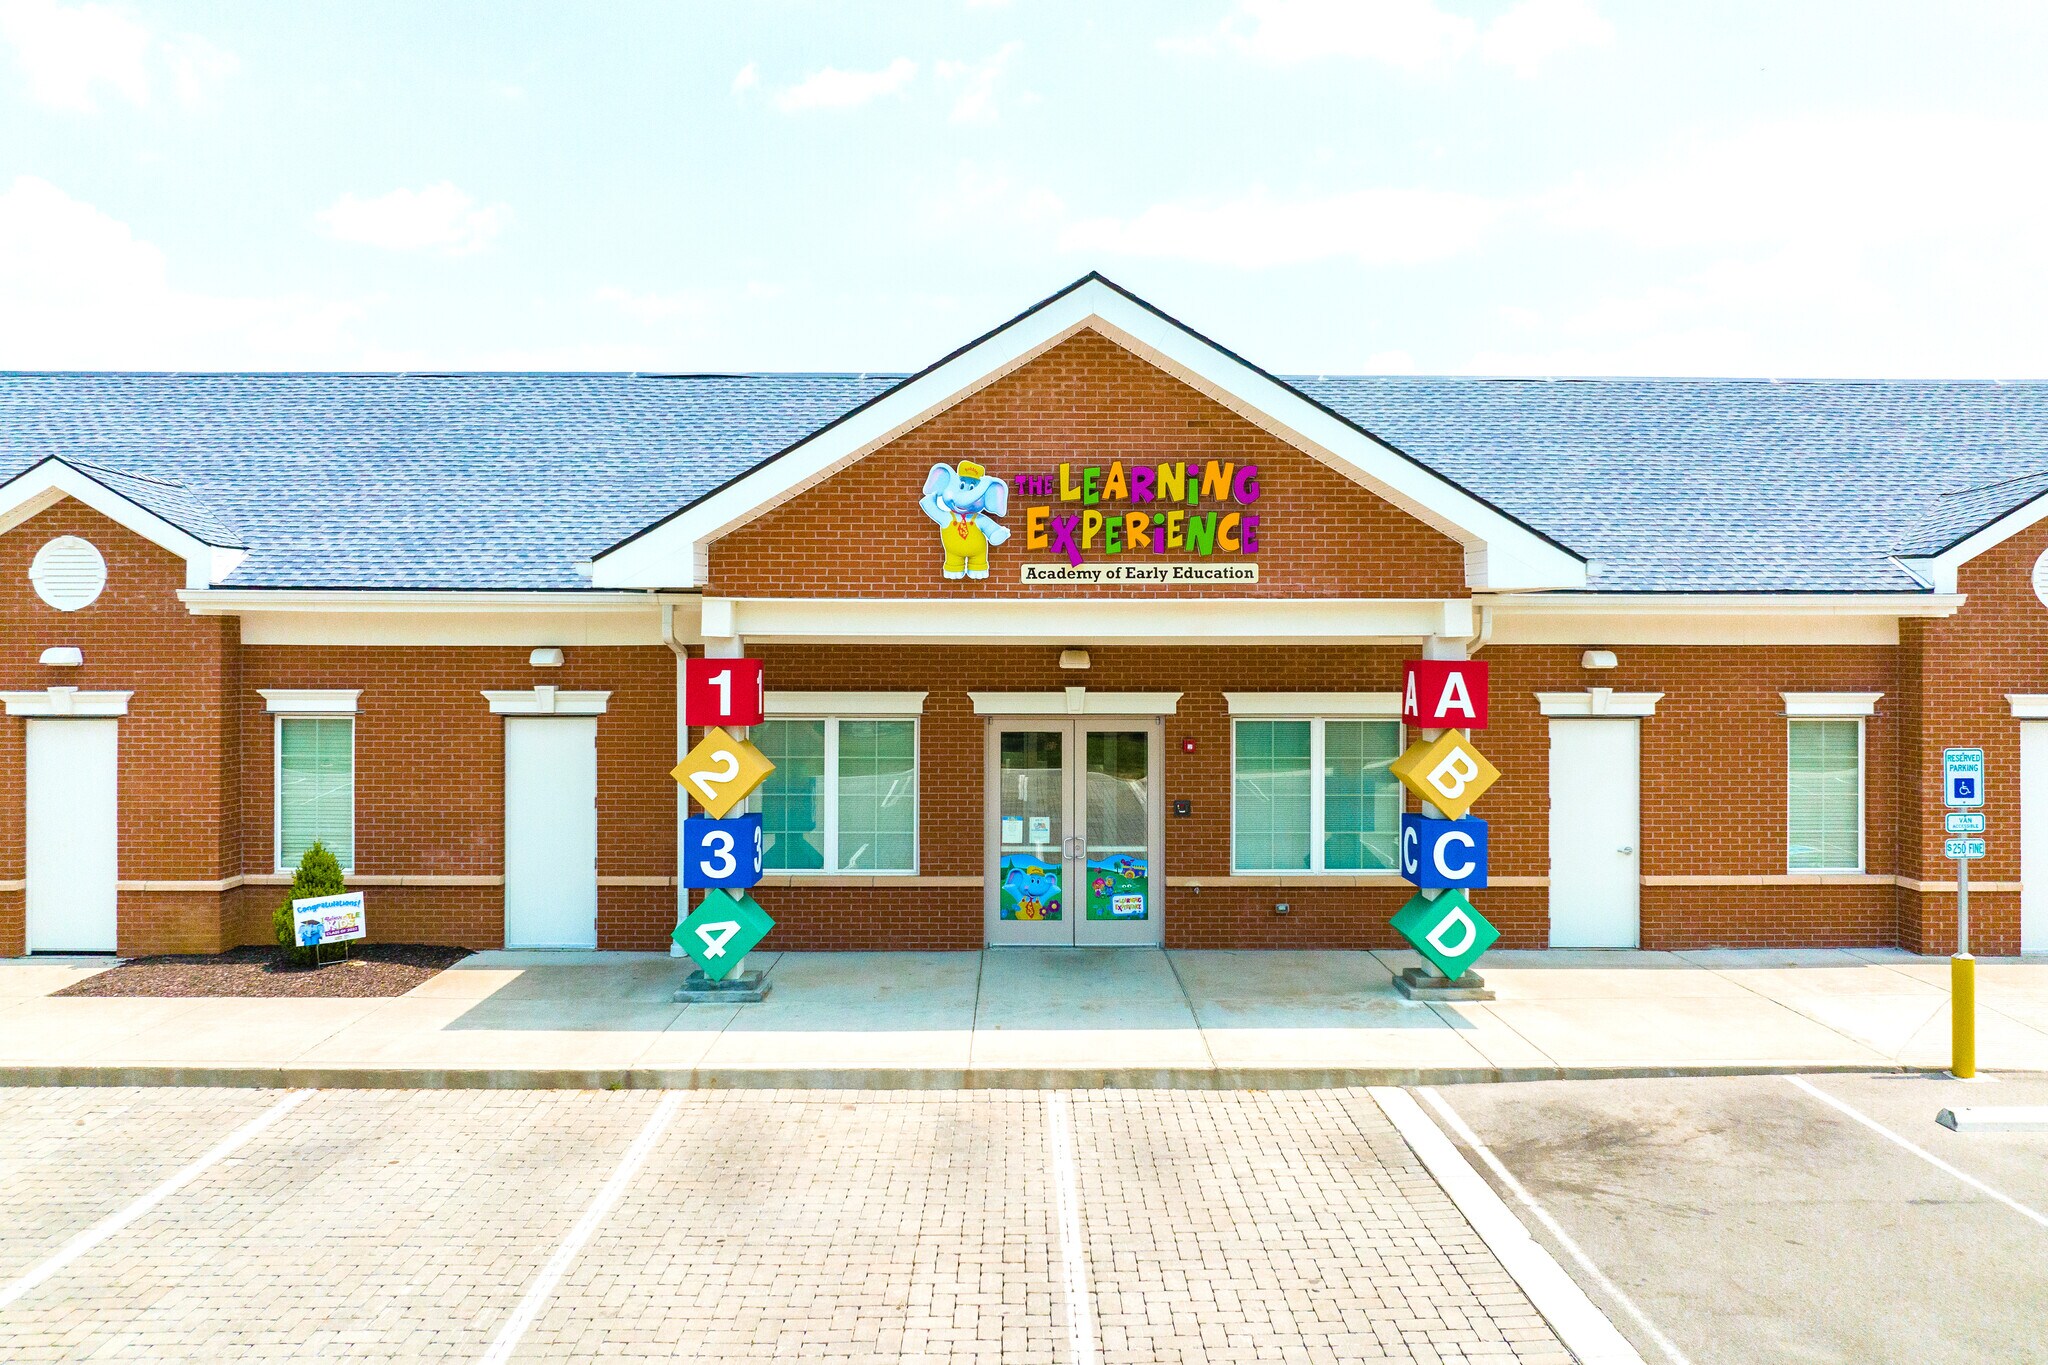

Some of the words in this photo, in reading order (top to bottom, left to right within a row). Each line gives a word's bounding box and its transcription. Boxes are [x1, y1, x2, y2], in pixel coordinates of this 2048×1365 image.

[1014, 473, 1053, 496] THE
[1025, 567, 1101, 582] Academy
[1106, 566, 1122, 579] of
[1125, 566, 1168, 582] Early
[1172, 566, 1254, 579] Education
[708, 669, 732, 716] 1
[1404, 670, 1418, 717] A
[1433, 671, 1476, 718] A
[688, 750, 740, 801] 2
[1426, 745, 1479, 799] B
[1947, 754, 1980, 762] RESERVED
[1949, 764, 1978, 772] PARKING
[700, 830, 737, 879] 3
[1403, 826, 1418, 875] C
[1433, 831, 1476, 880] C
[1968, 843, 1984, 854] FINE
[297, 900, 361, 913] Congratulations!
[695, 920, 741, 960] 4
[1425, 906, 1477, 957] D
